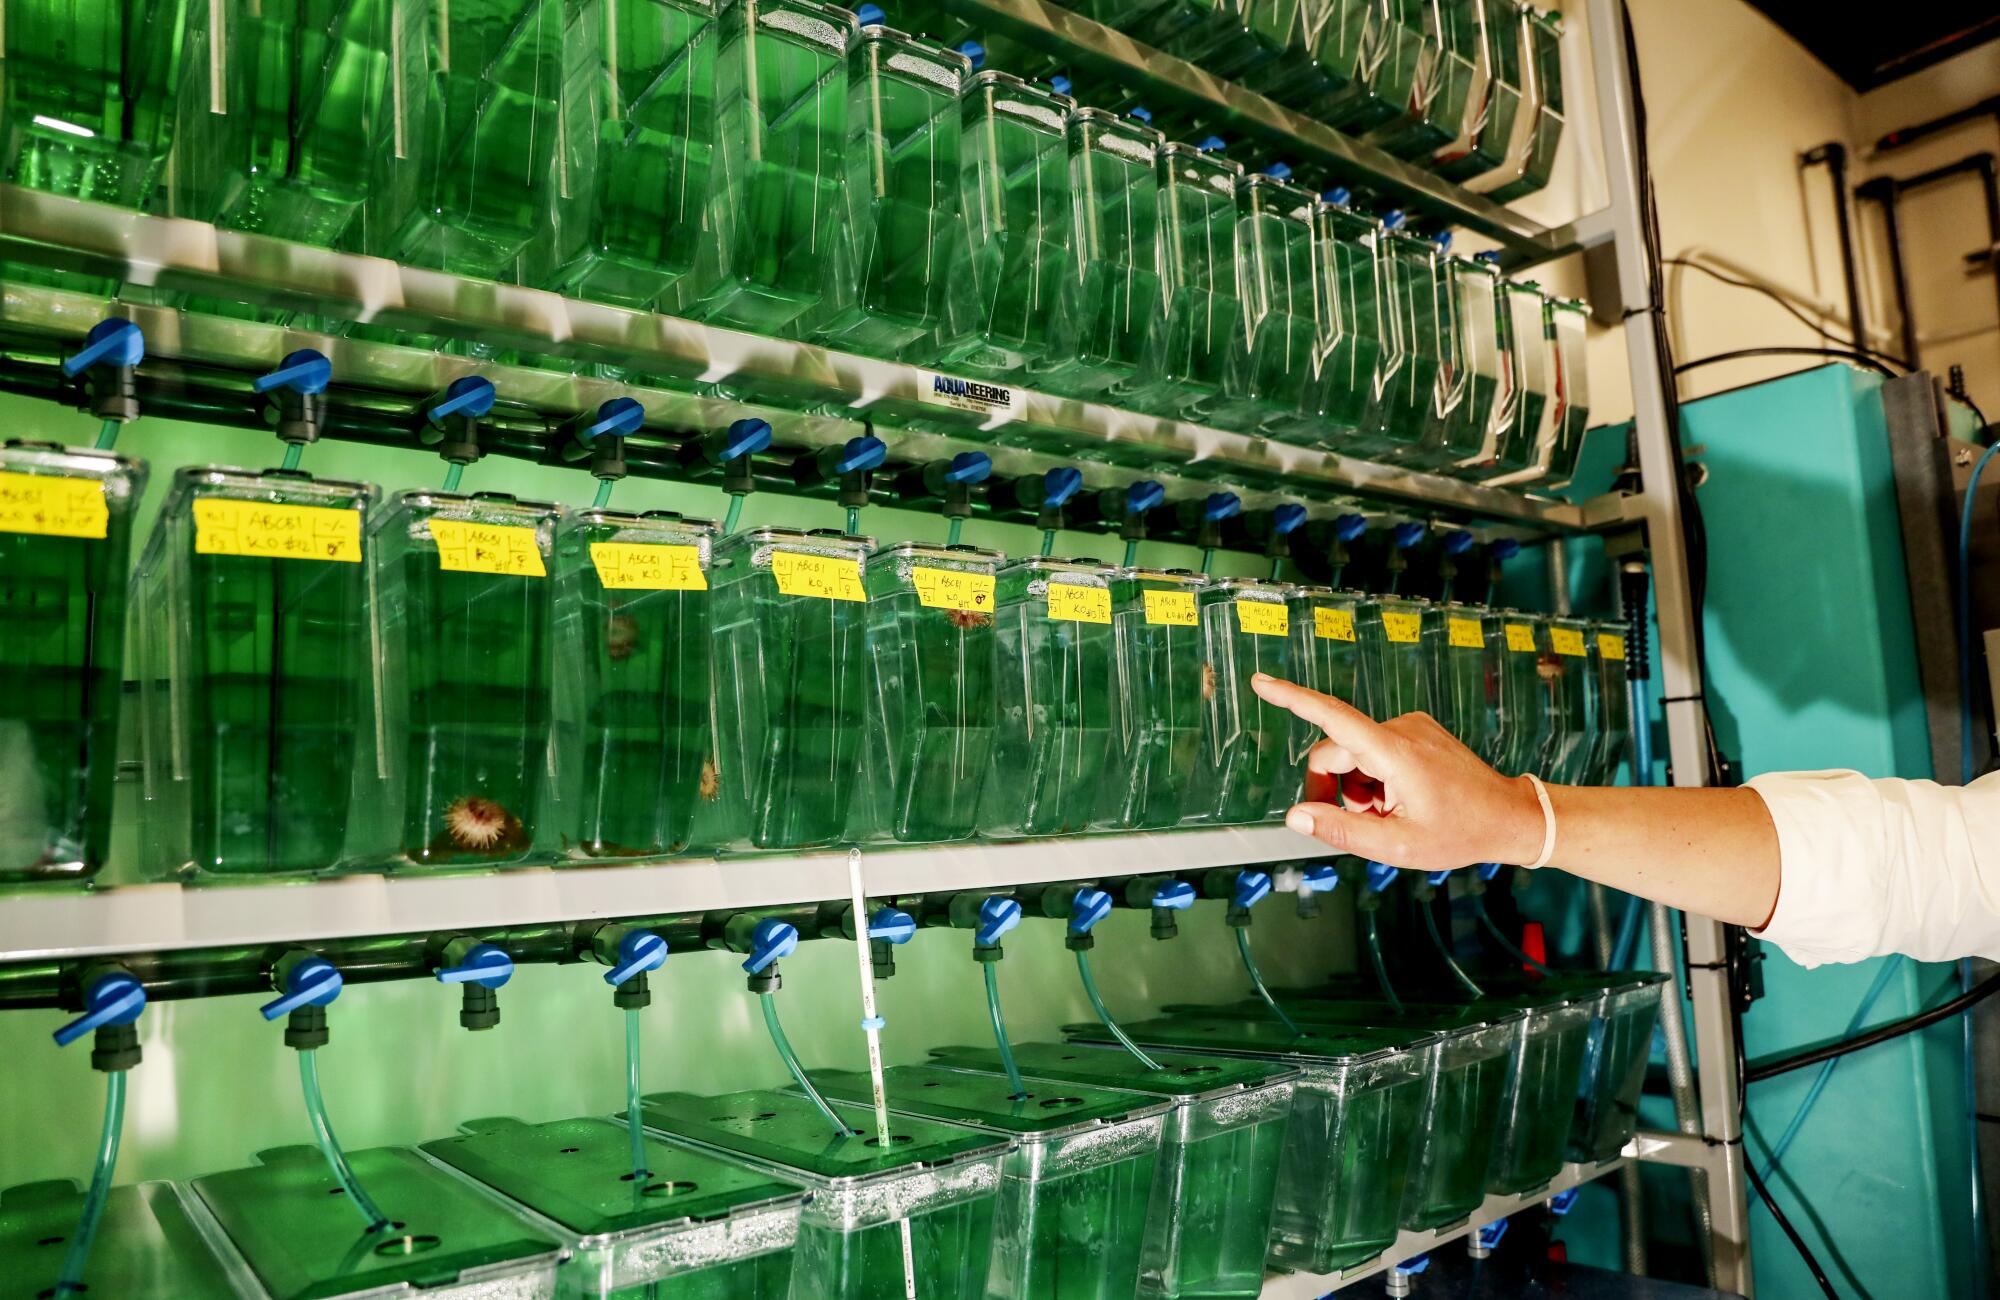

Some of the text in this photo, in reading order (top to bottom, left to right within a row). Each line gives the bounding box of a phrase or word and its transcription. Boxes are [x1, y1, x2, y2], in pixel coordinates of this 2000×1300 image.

[934, 375, 1010, 402] AQUANEERING
[249, 511, 303, 531] ABCB1
[468, 530, 502, 546] ABCB1
[627, 553, 660, 566] ABCB1
[796, 560, 825, 573] ABCB1
[808, 577, 823, 588] KO
[941, 575, 962, 590] ABCB1
